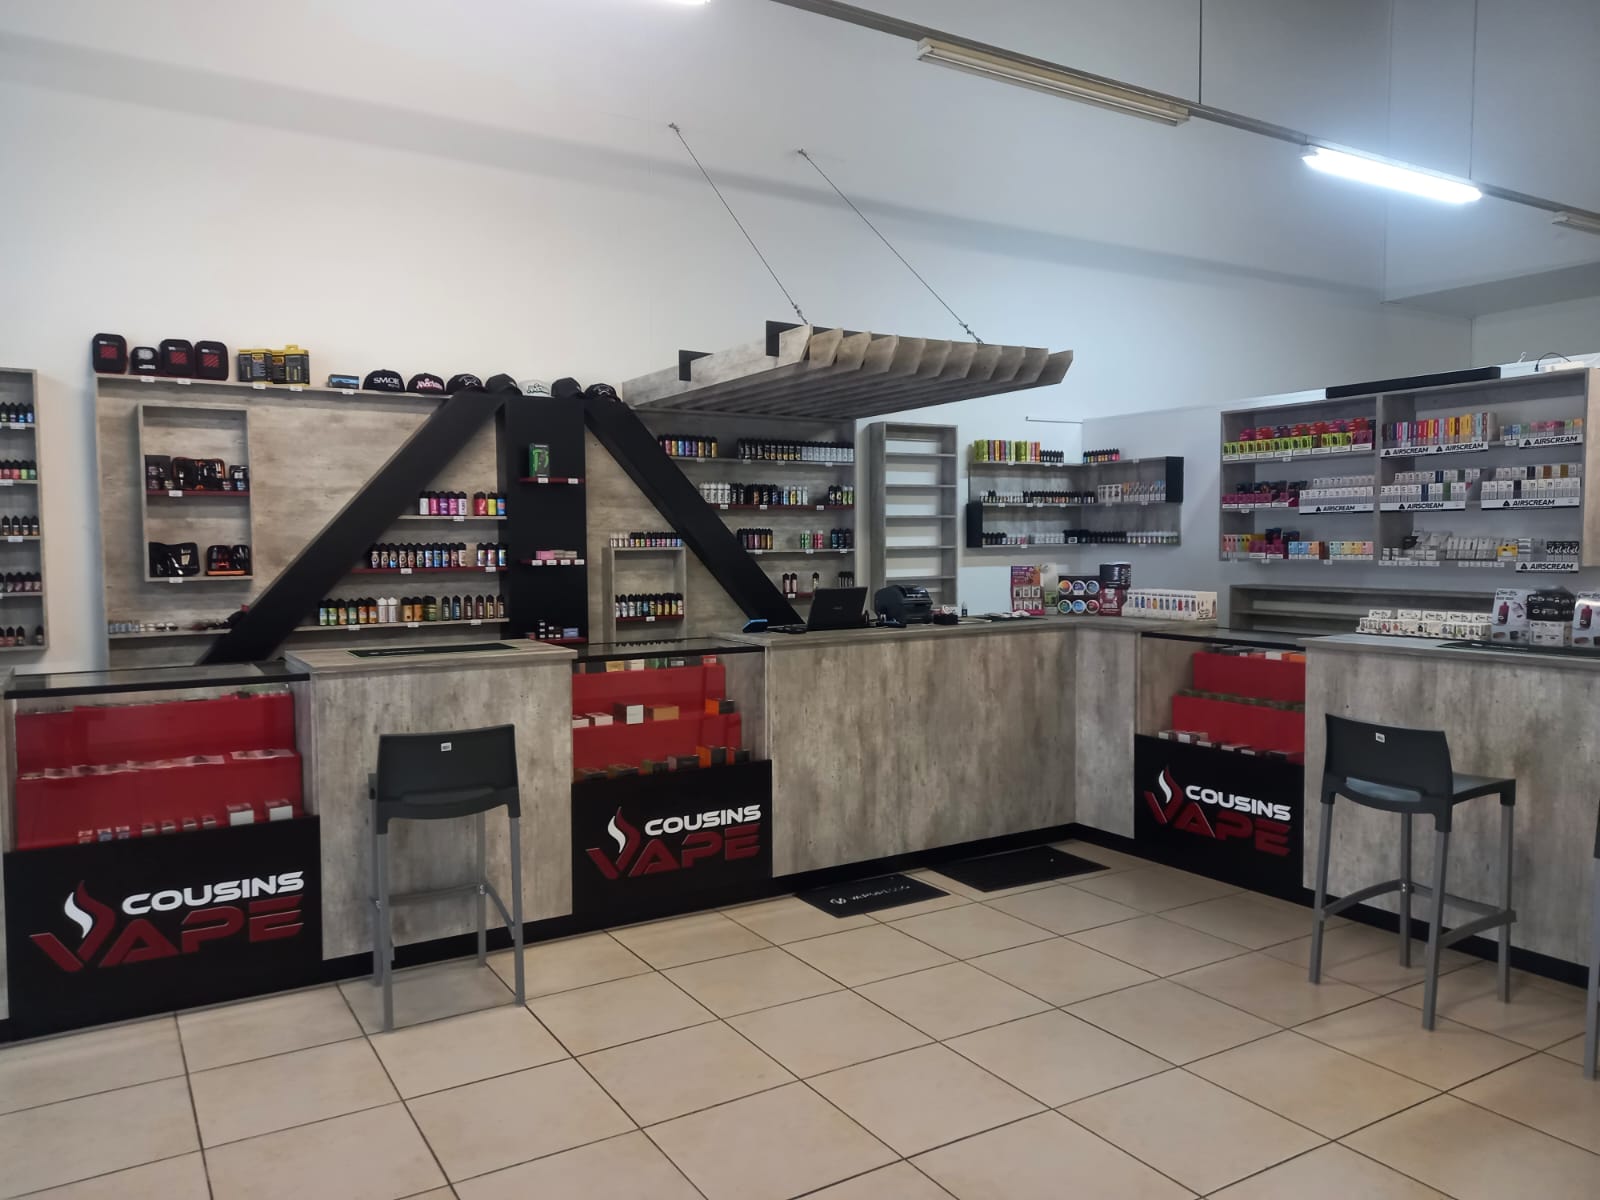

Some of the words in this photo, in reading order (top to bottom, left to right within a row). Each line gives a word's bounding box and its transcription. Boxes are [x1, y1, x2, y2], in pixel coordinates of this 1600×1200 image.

[1392, 447, 1429, 455] AIRSCREAM
[1445, 442, 1484, 452] AIRSCREAM
[1534, 435, 1578, 445] AIRSCREAM
[644, 804, 762, 836] COUSINS
[1144, 766, 1292, 857] VAPE
[1185, 784, 1292, 821] COUSINS
[585, 806, 761, 880] VAPE
[121, 871, 305, 915] COUSINS
[29, 880, 304, 973] VAPE
